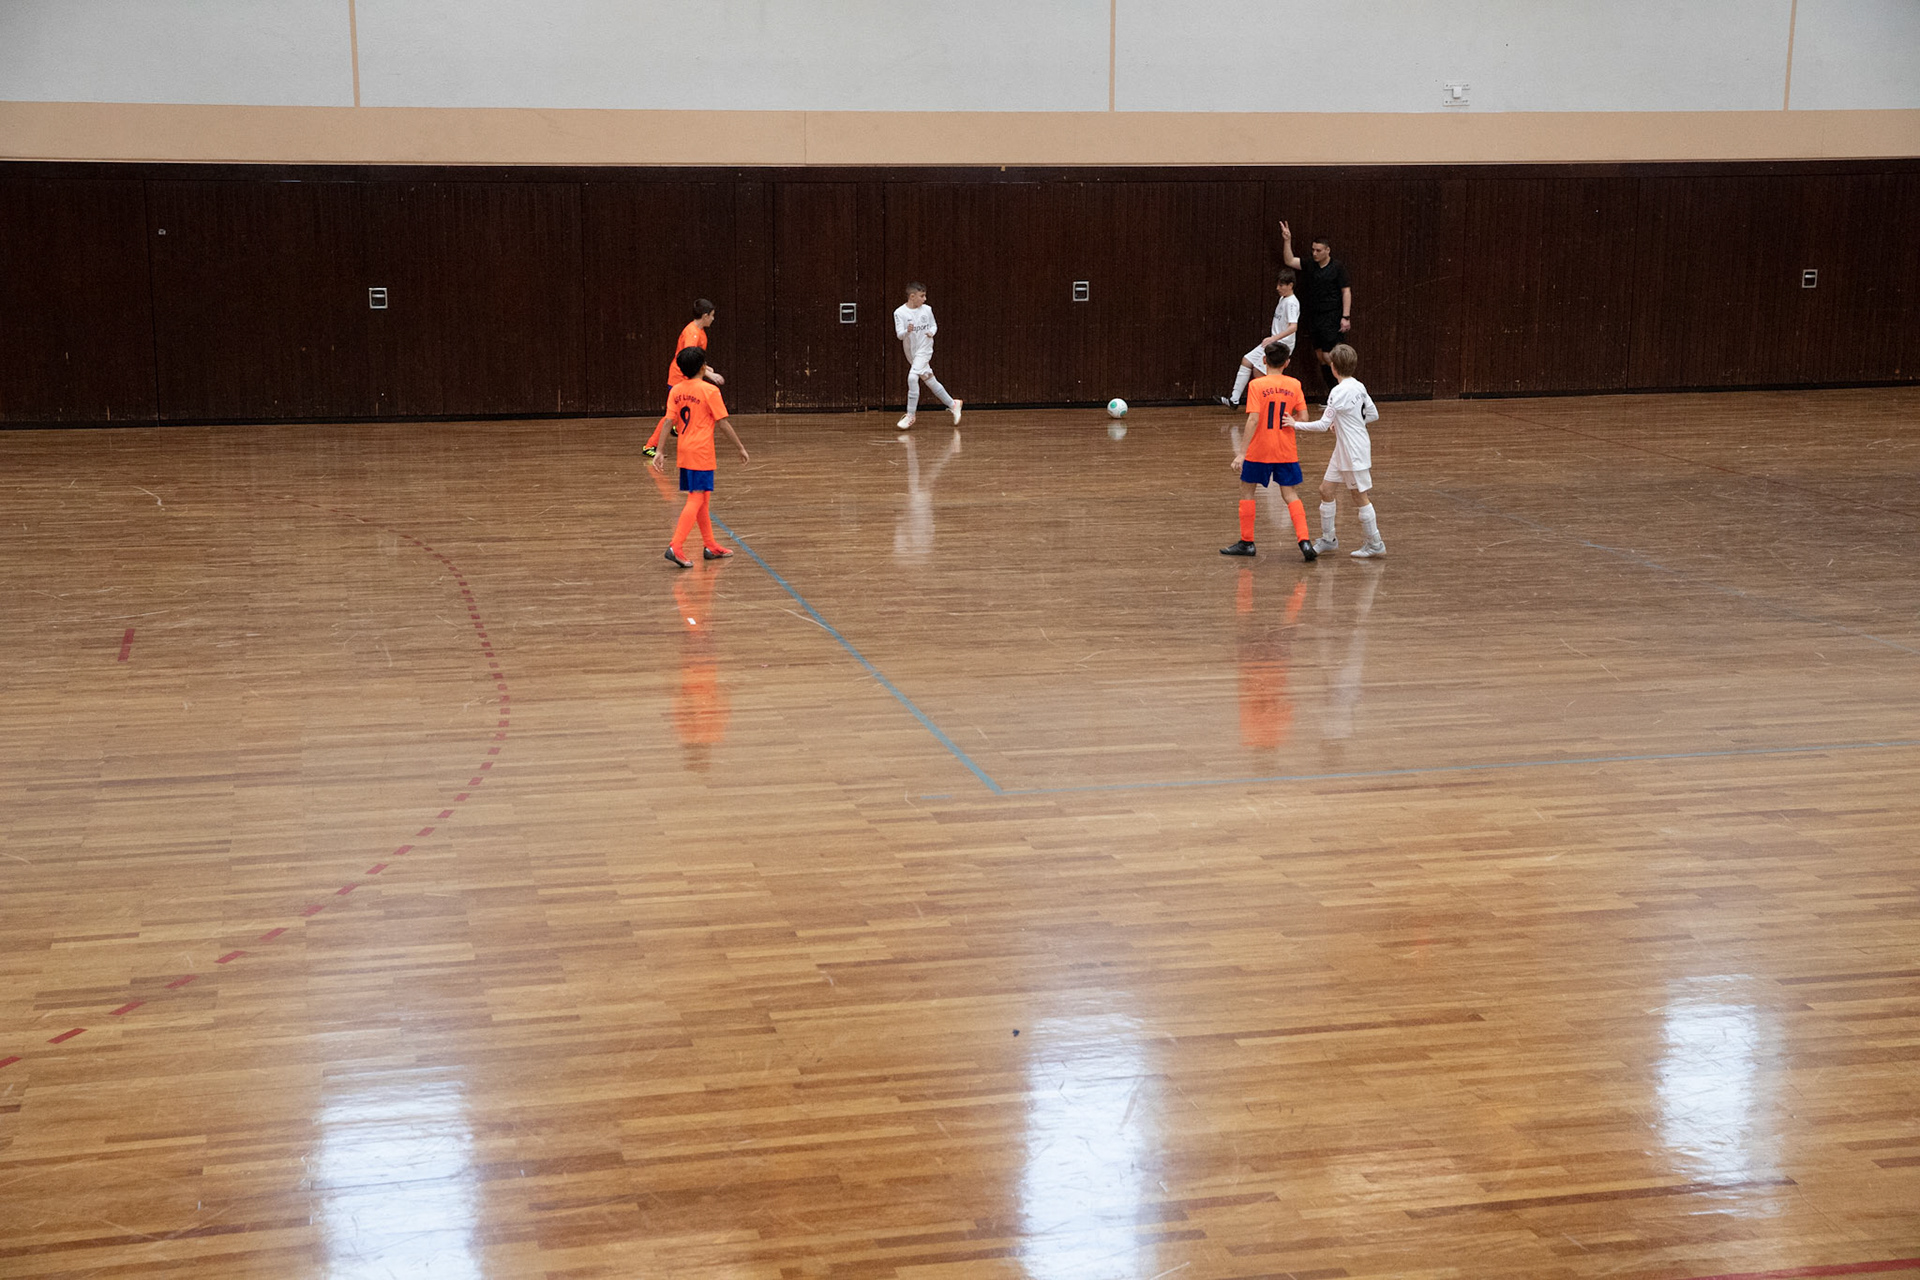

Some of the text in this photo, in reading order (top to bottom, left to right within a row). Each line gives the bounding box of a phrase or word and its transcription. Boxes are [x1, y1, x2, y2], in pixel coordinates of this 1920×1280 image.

[1262, 386, 1295, 398] SSG Lingen
[680, 405, 691, 435] 9
[1267, 401, 1287, 430] 11
